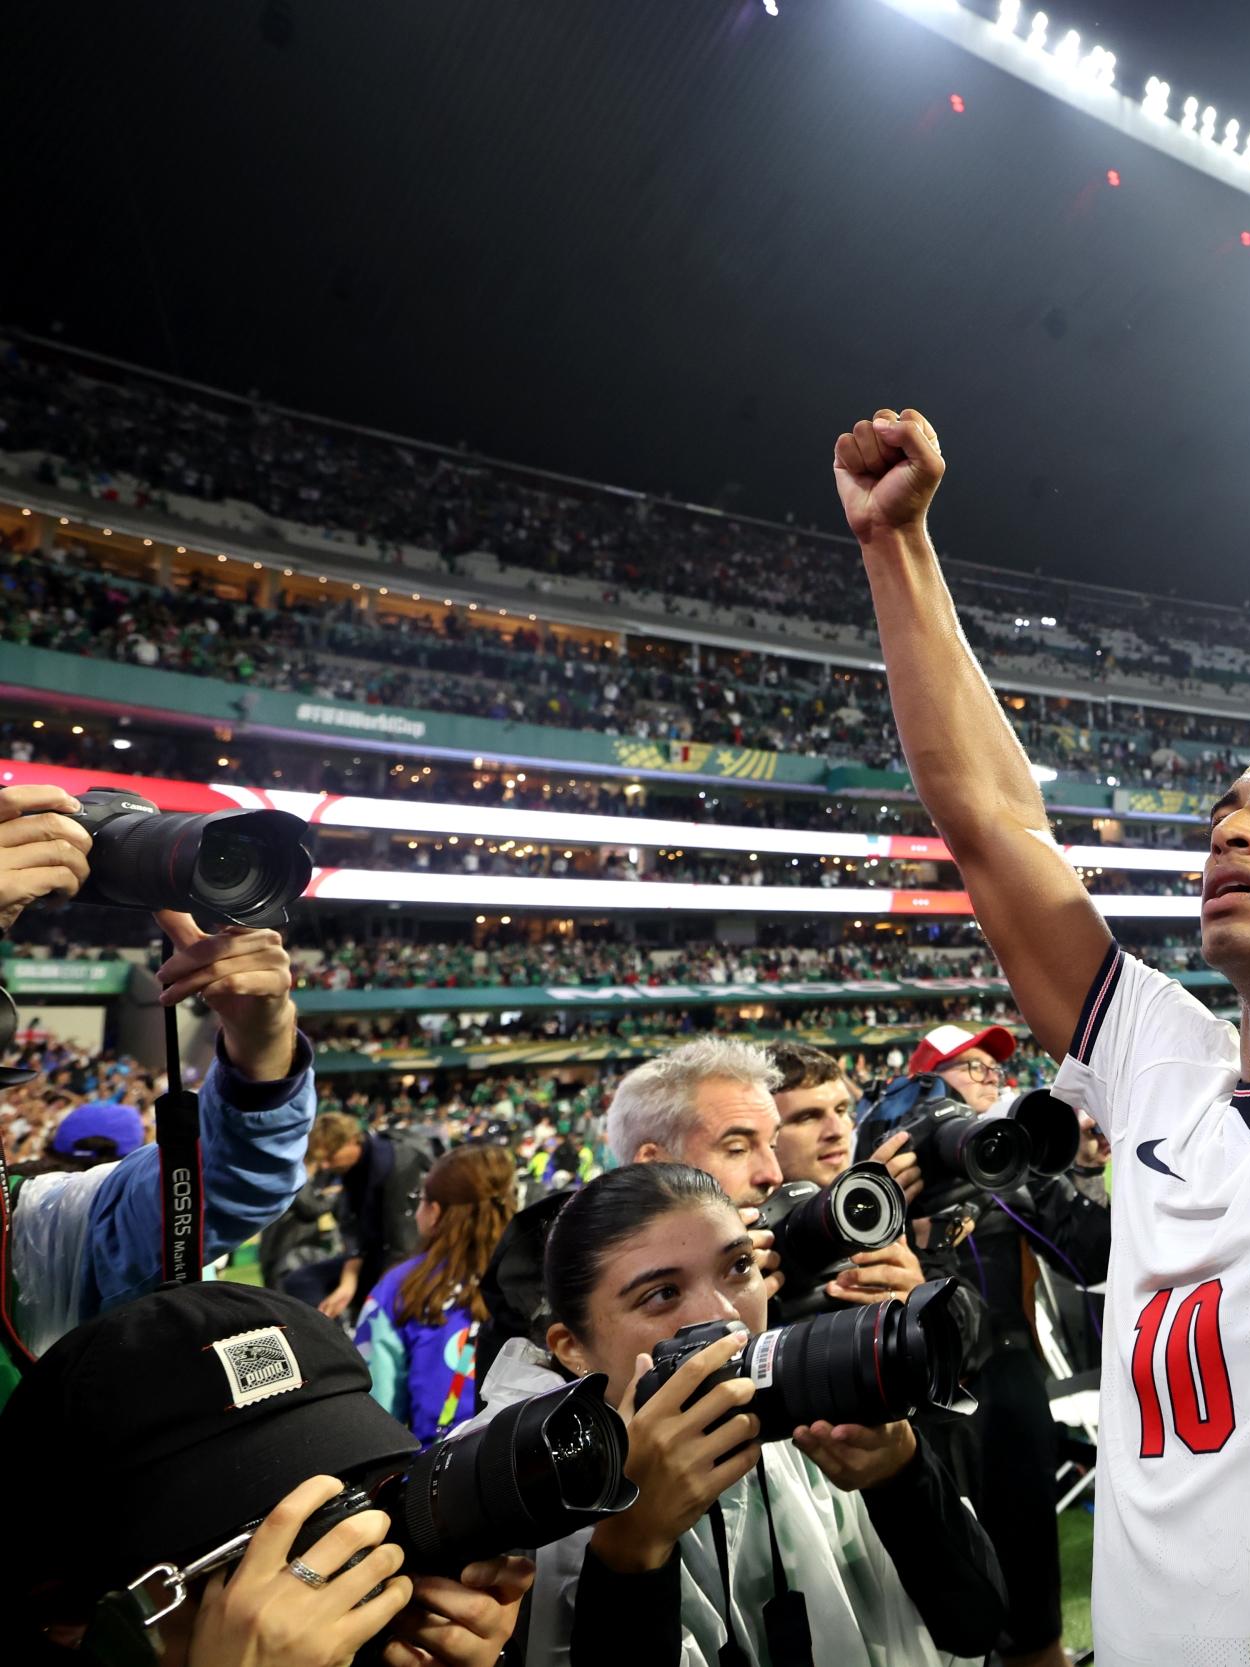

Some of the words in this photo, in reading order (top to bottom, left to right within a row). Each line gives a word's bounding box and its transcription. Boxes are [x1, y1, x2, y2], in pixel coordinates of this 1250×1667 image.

[172, 1168, 192, 1212] EOS
[174, 1213, 192, 1236] R5
[174, 1241, 187, 1272] Mark
[245, 1362, 284, 1385] PUMA
[1131, 1277, 1236, 1459] 10
